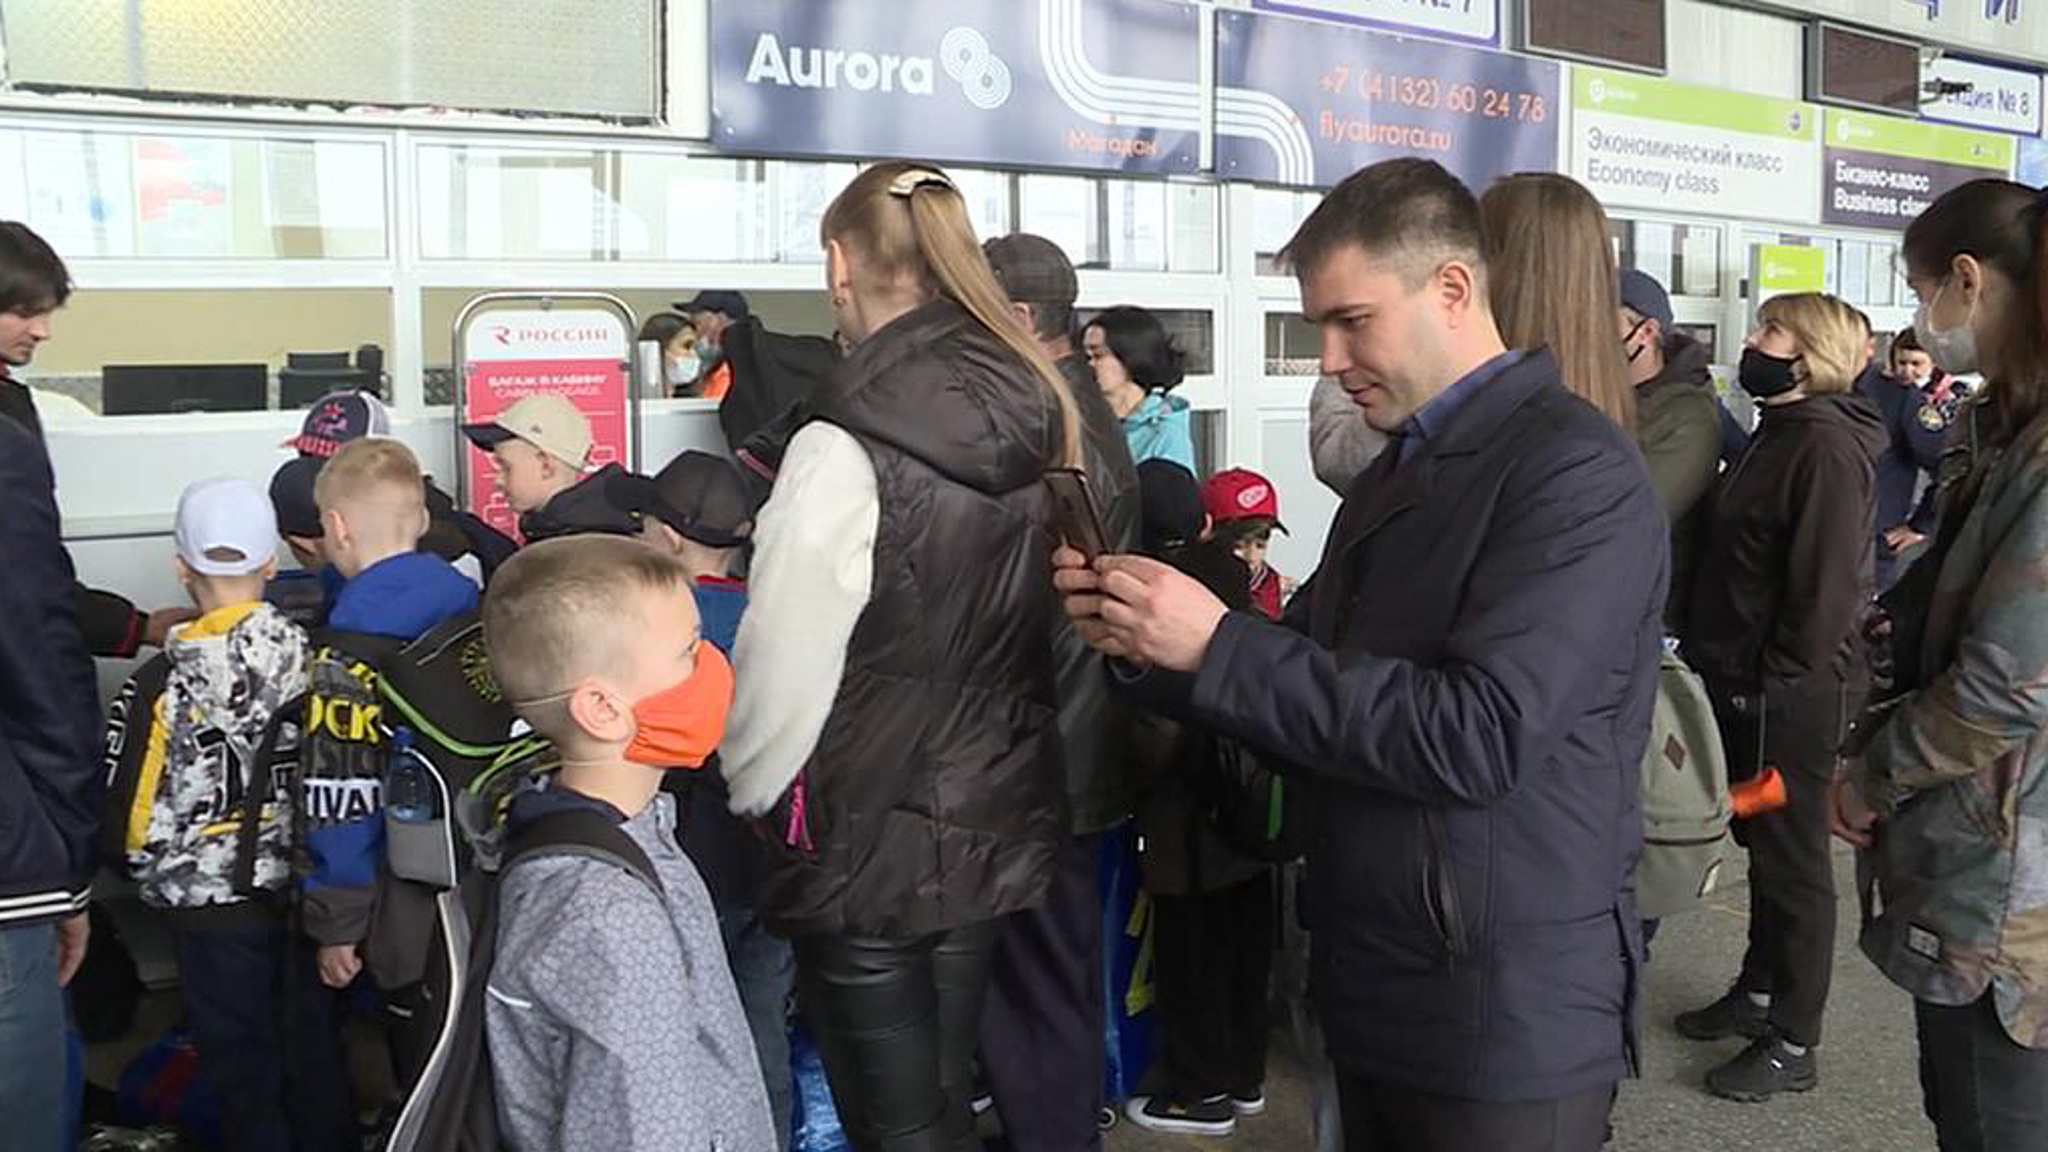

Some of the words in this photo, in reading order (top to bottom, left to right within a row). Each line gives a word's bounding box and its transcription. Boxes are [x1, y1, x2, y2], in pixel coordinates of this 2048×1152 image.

[746, 33, 933, 94] Aurora
[1448, 85, 1476, 112] 60
[1483, 89, 1510, 118] 24
[1517, 93, 1545, 123] 78
[2020, 92, 2029, 116] 8
[1319, 110, 1452, 150] flyaurora.ru
[1587, 126, 1732, 167] Экономический
[1735, 153, 1783, 174] класс
[1587, 158, 1672, 193] Economy
[1674, 170, 1720, 195] class
[1834, 158, 1930, 192] Бизнес-класс
[1833, 187, 1897, 215] Business
